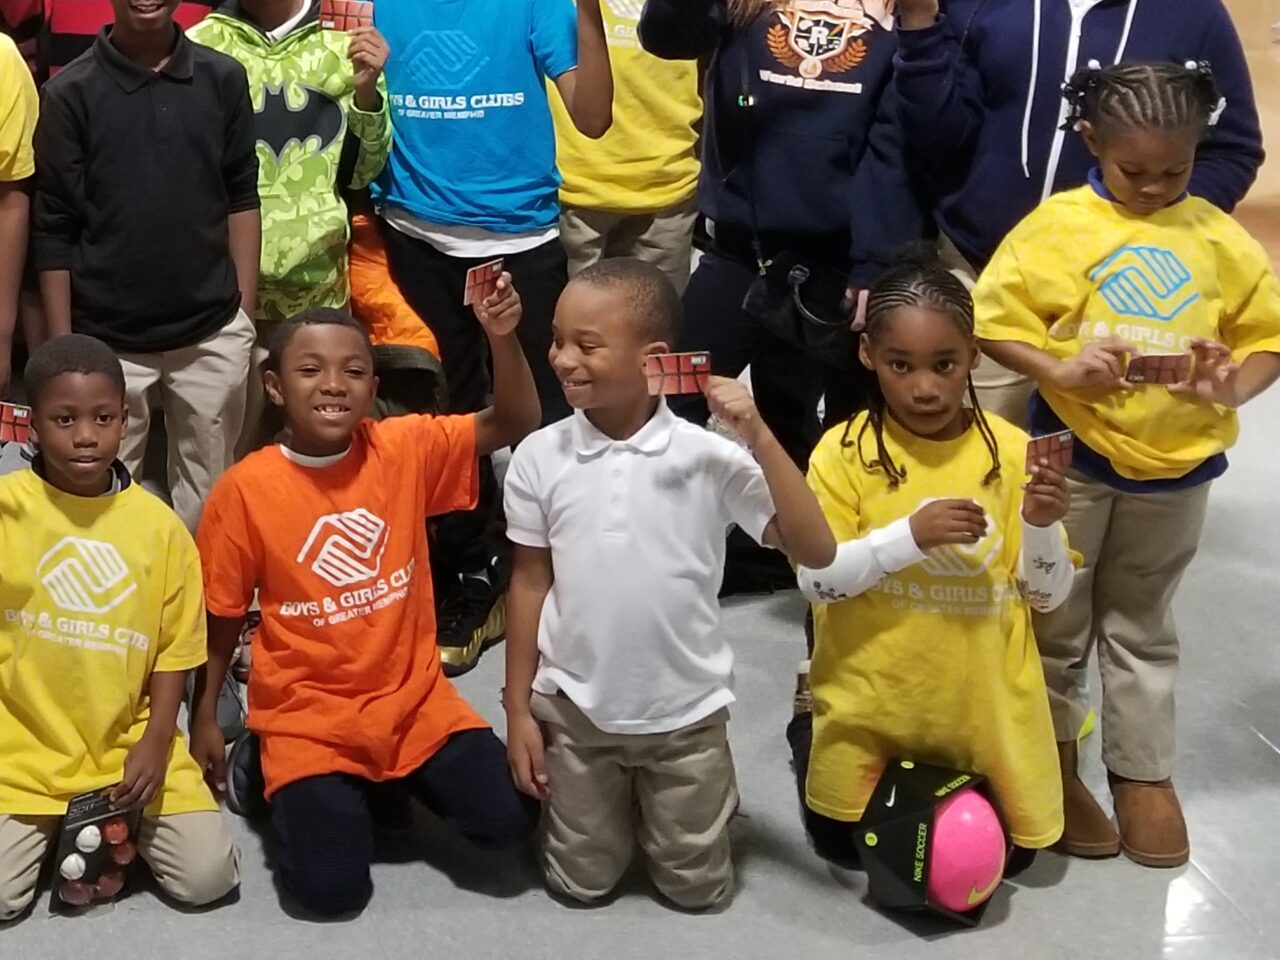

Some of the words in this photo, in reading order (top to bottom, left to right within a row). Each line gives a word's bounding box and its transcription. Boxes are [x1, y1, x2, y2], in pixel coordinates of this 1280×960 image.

[405, 94, 418, 108] &
[419, 96, 467, 109] GIRLS
[470, 92, 524, 108] CLUBS
[1115, 323, 1175, 348] GIRLS
[279, 601, 320, 616] BOYS
[322, 596, 337, 613] &
[340, 579, 389, 608] GIRLS
[908, 582, 925, 599] &
[930, 584, 988, 602] GIRLS
[38, 611, 52, 628] &
[56, 616, 110, 639] GIRLS
[313, 617, 326, 627] OF
[328, 605, 372, 625] GREATER
[917, 823, 927, 859] SOCCER
[913, 860, 922, 882] NIKE
